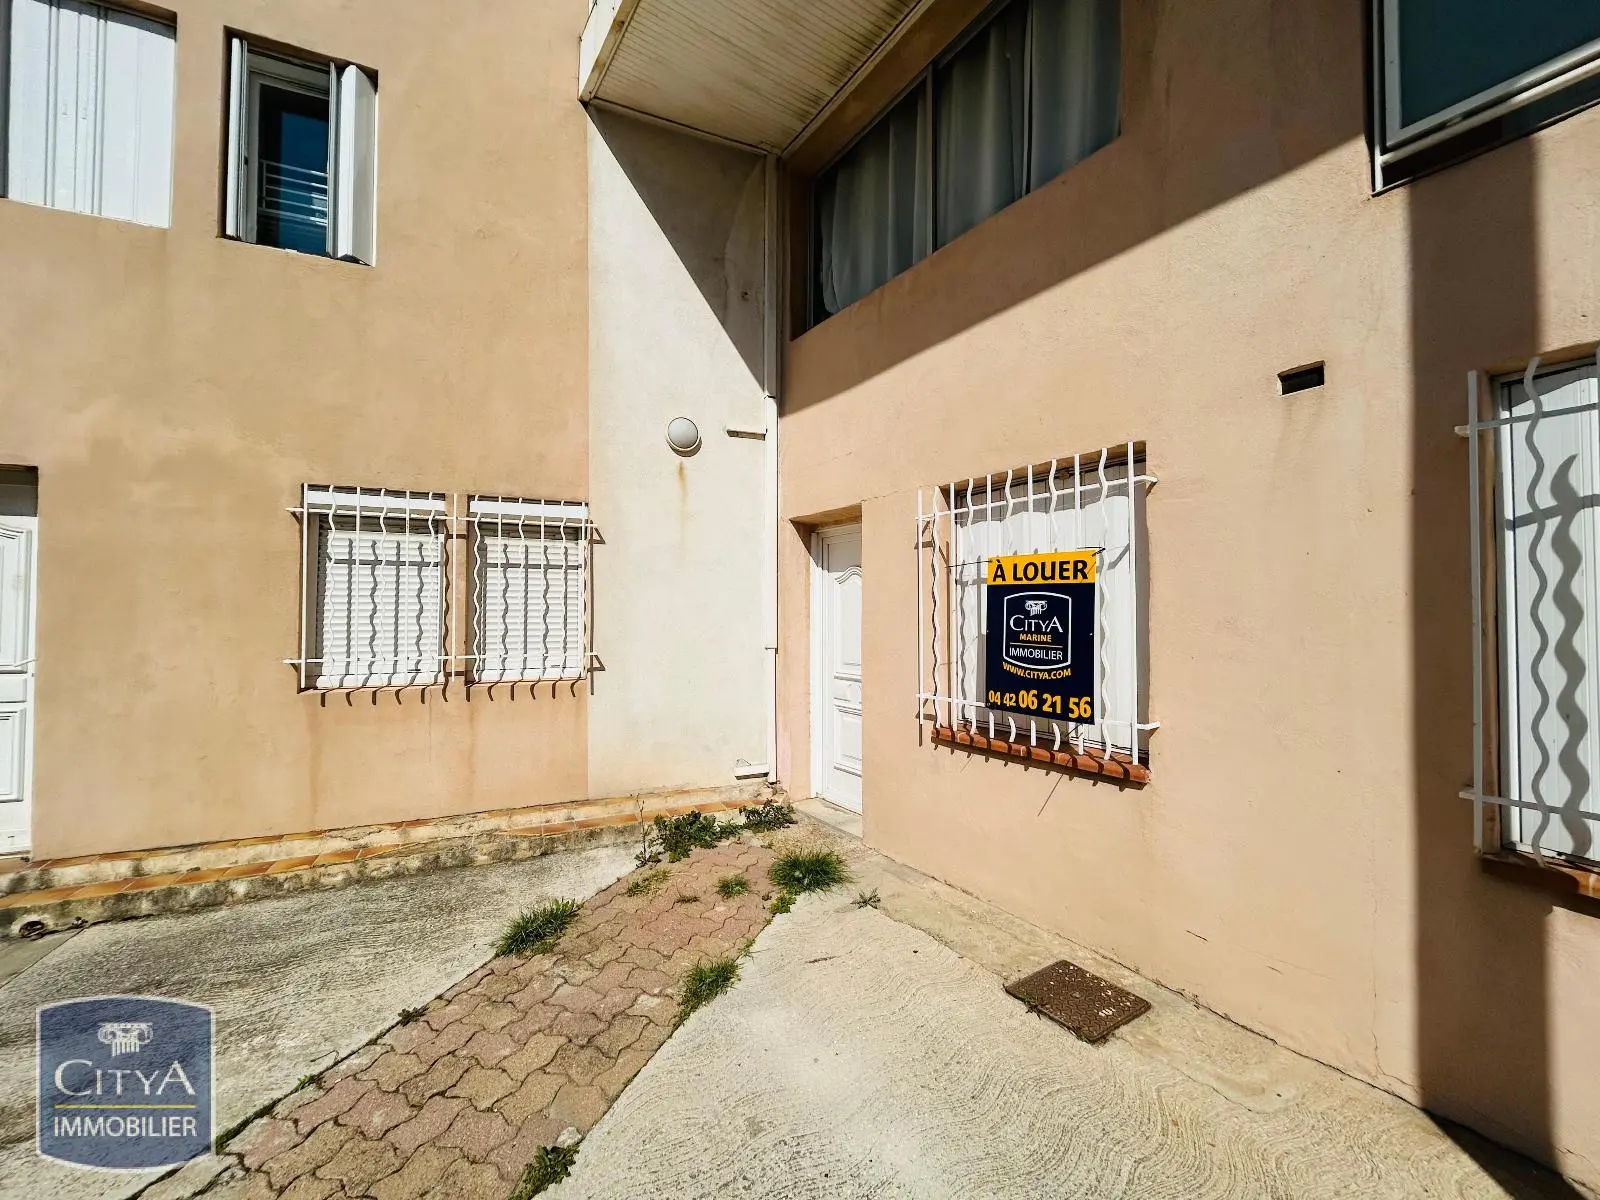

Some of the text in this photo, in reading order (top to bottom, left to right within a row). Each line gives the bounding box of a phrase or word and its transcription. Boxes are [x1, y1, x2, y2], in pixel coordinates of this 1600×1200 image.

[993, 559, 1088, 582] À LOUER
[1020, 633, 1052, 642] MARINE
[1009, 647, 1063, 660] IMMOBILIER
[1002, 662, 1071, 679] WWW.CITYA.COM
[988, 690, 1091, 718] 04 42 06 21 56
